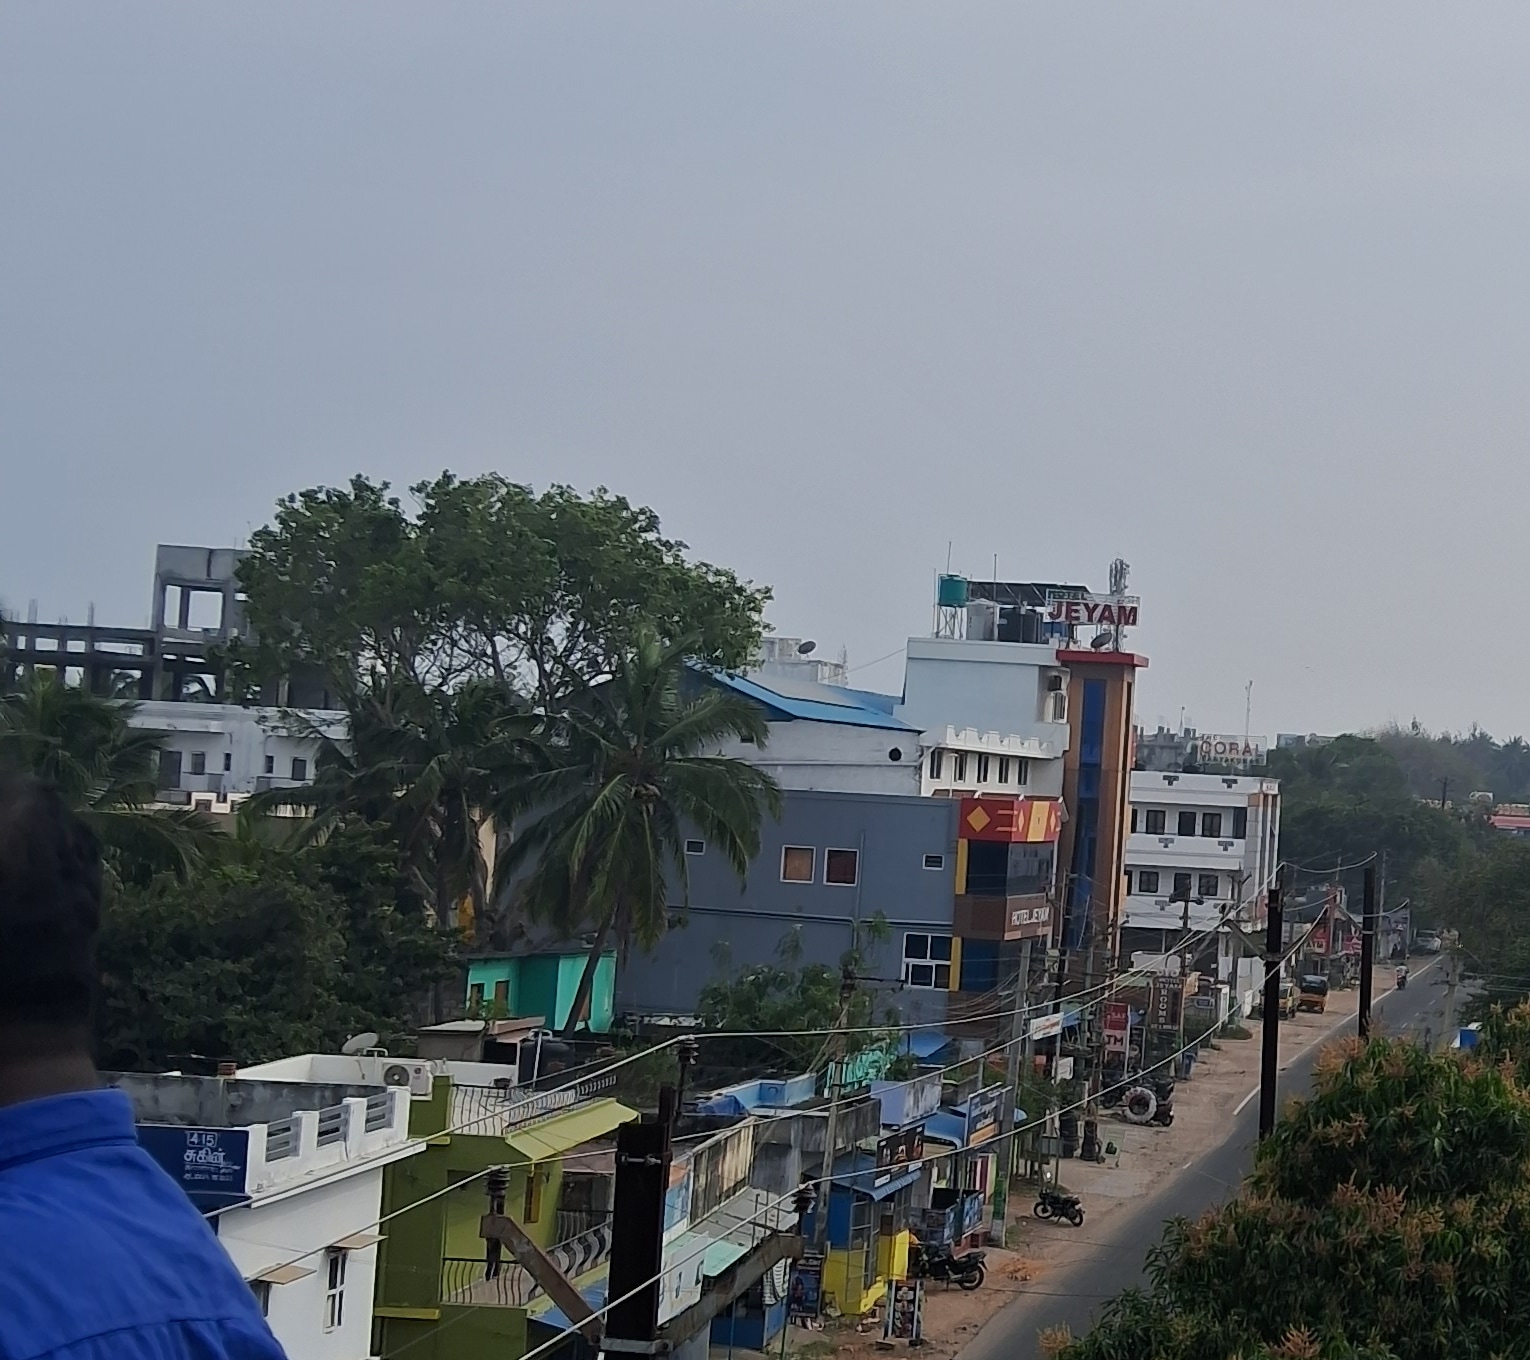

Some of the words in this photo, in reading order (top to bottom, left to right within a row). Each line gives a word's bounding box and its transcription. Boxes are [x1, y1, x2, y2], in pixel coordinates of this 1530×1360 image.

[1048, 601, 1138, 626] JEYAM
[1011, 909, 1031, 926] HOTEL
[1031, 906, 1050, 923] JEYAM
[1105, 1034, 1124, 1047] TM
